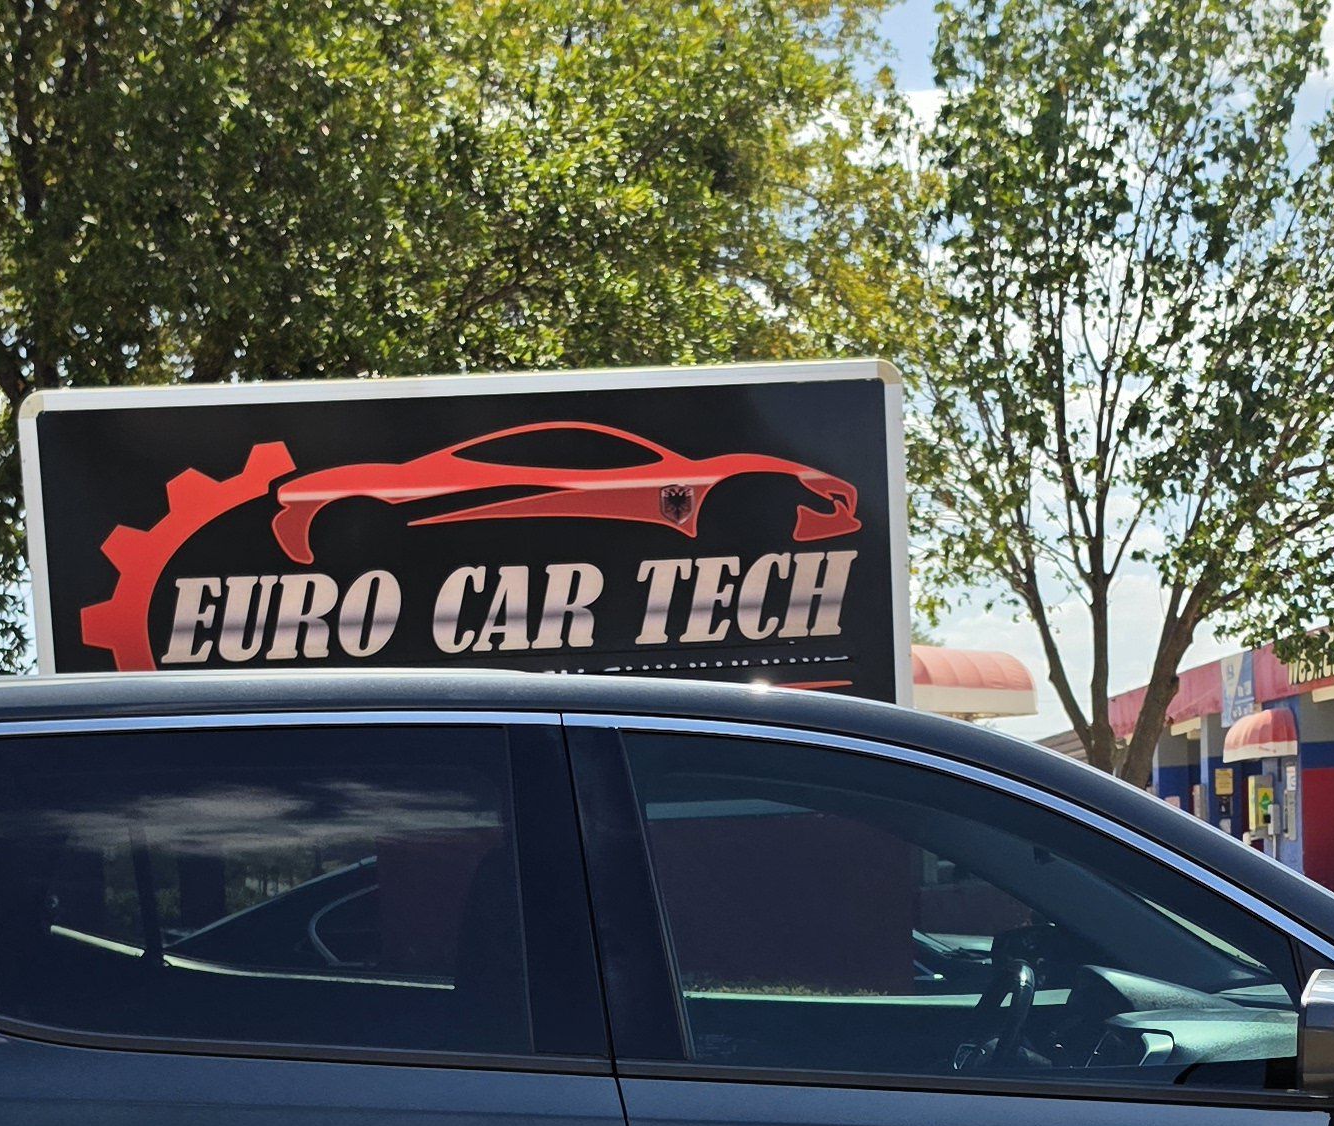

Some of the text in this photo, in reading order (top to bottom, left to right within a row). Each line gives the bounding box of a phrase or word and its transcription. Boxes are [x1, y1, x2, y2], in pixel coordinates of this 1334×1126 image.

[161, 550, 858, 663] EURO CAR TECH
